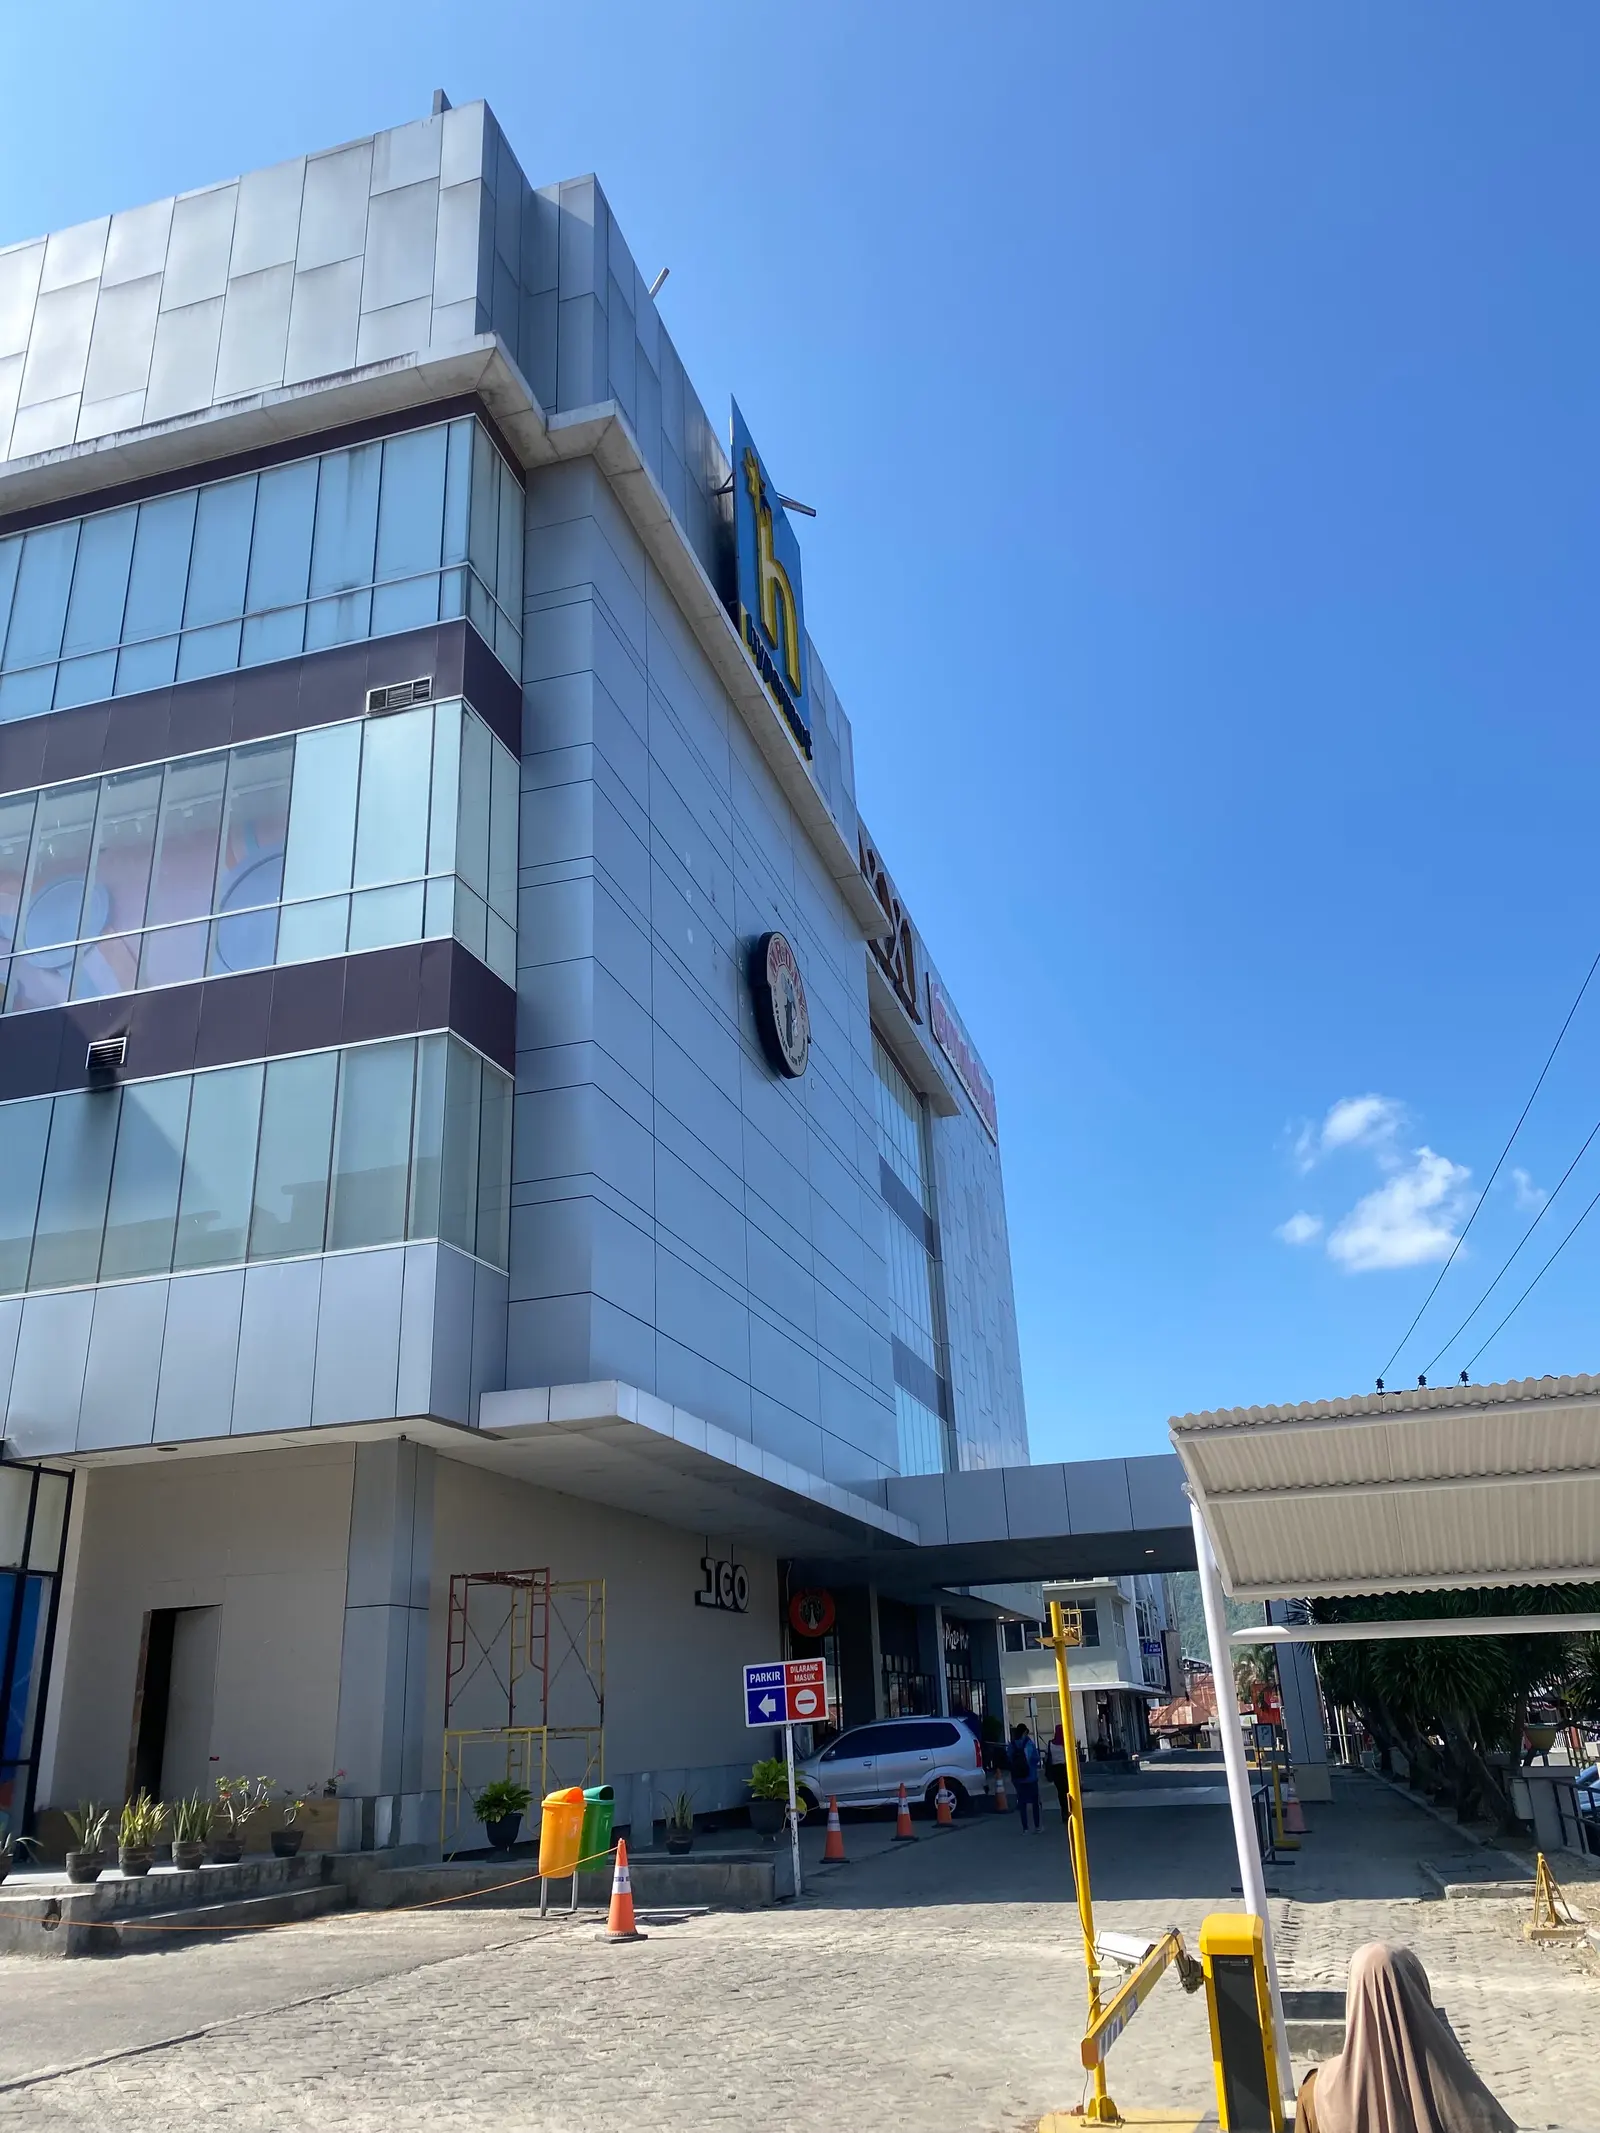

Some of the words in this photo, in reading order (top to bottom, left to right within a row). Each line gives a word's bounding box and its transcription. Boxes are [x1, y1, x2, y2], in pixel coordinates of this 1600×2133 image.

[790, 1663, 819, 1674] DILARANG
[749, 1671, 781, 1683] PARKIR
[794, 1673, 816, 1682] MASUK
